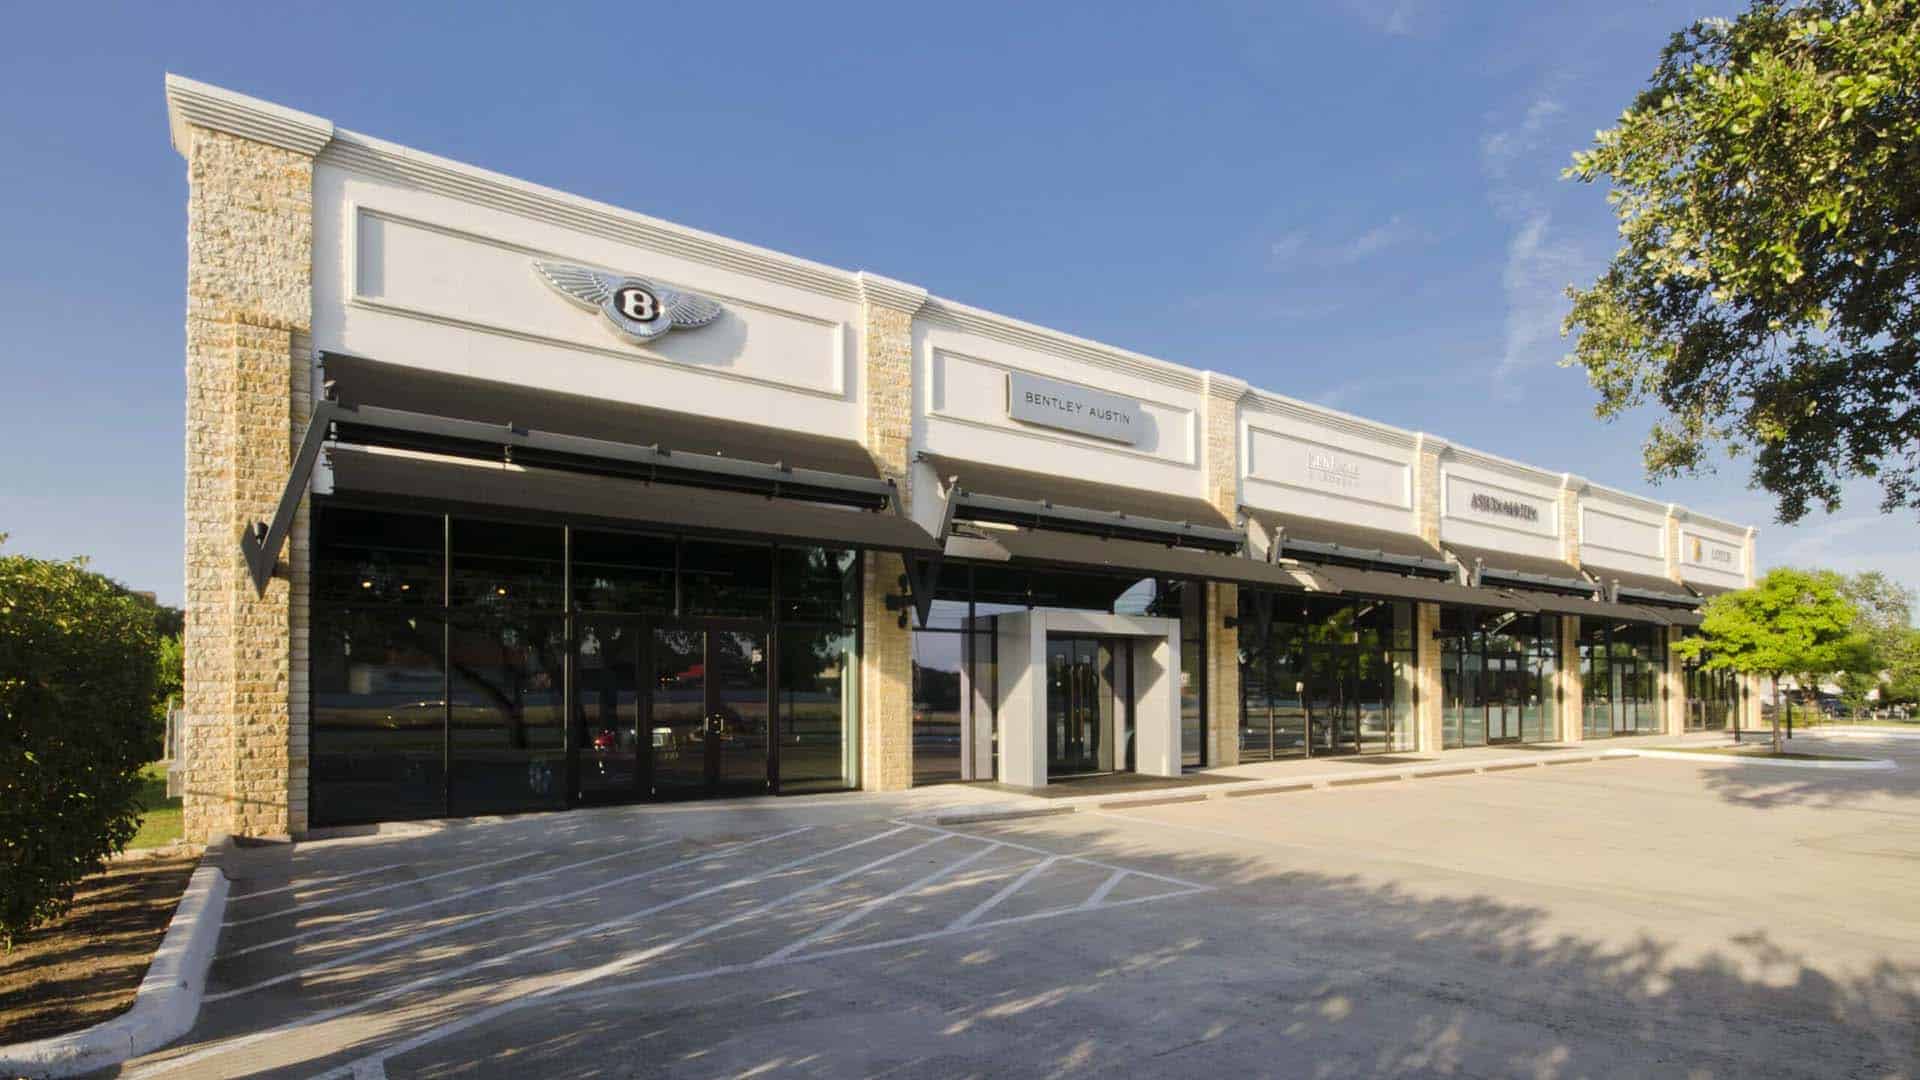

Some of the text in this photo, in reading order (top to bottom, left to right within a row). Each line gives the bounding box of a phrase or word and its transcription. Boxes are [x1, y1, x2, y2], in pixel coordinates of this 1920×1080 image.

[623, 289, 654, 320] B
[1025, 391, 1130, 424] BENTLEY AUSTIN
